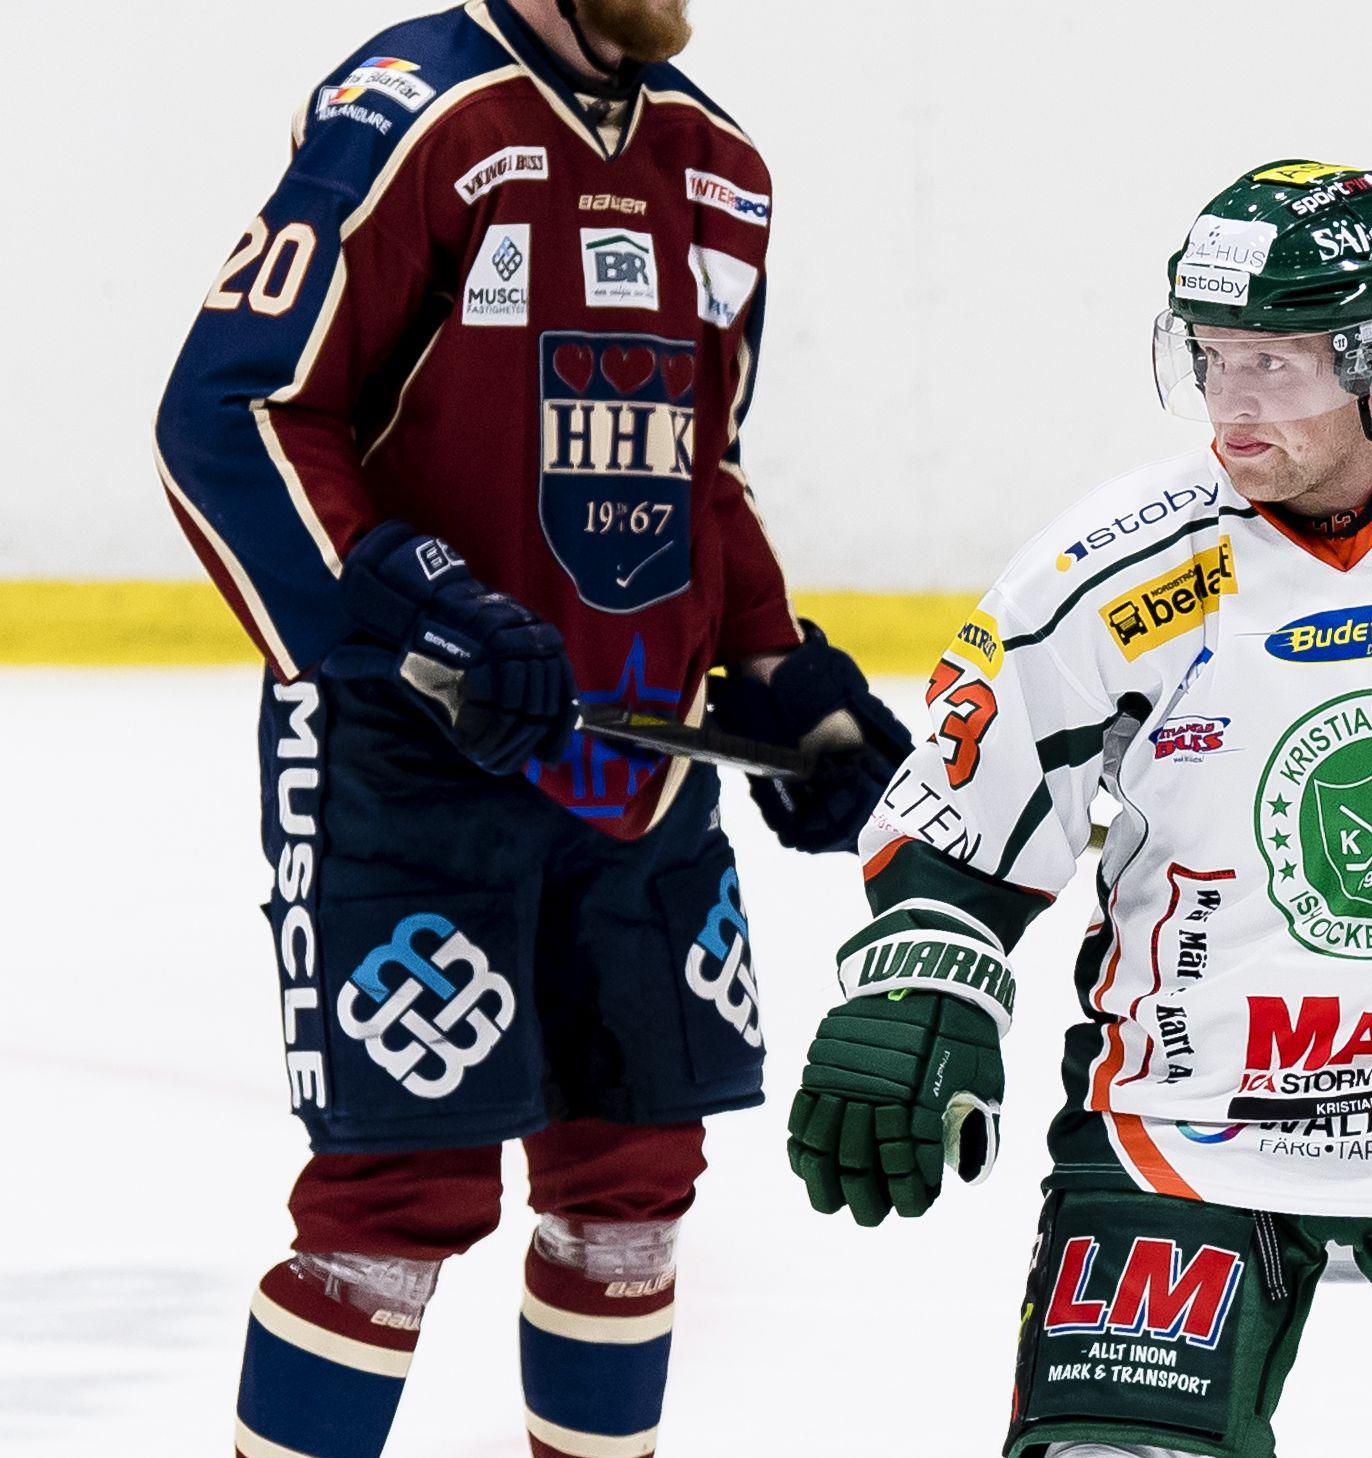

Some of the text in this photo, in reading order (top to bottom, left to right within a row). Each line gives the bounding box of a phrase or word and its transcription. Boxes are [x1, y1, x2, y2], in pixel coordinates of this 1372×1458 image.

[203, 215, 317, 317] 20
[1216, 245, 1267, 269] HUS
[273, 680, 327, 1110] MUSCLE
[1156, 1003, 1195, 1059] Kart
[1258, 1138, 1321, 1158] FÄRG
[1044, 1235, 1245, 1351] LM
[1129, 1344, 1177, 1368] INOM
[1048, 1362, 1212, 1397] MARK & TRANSPORT
